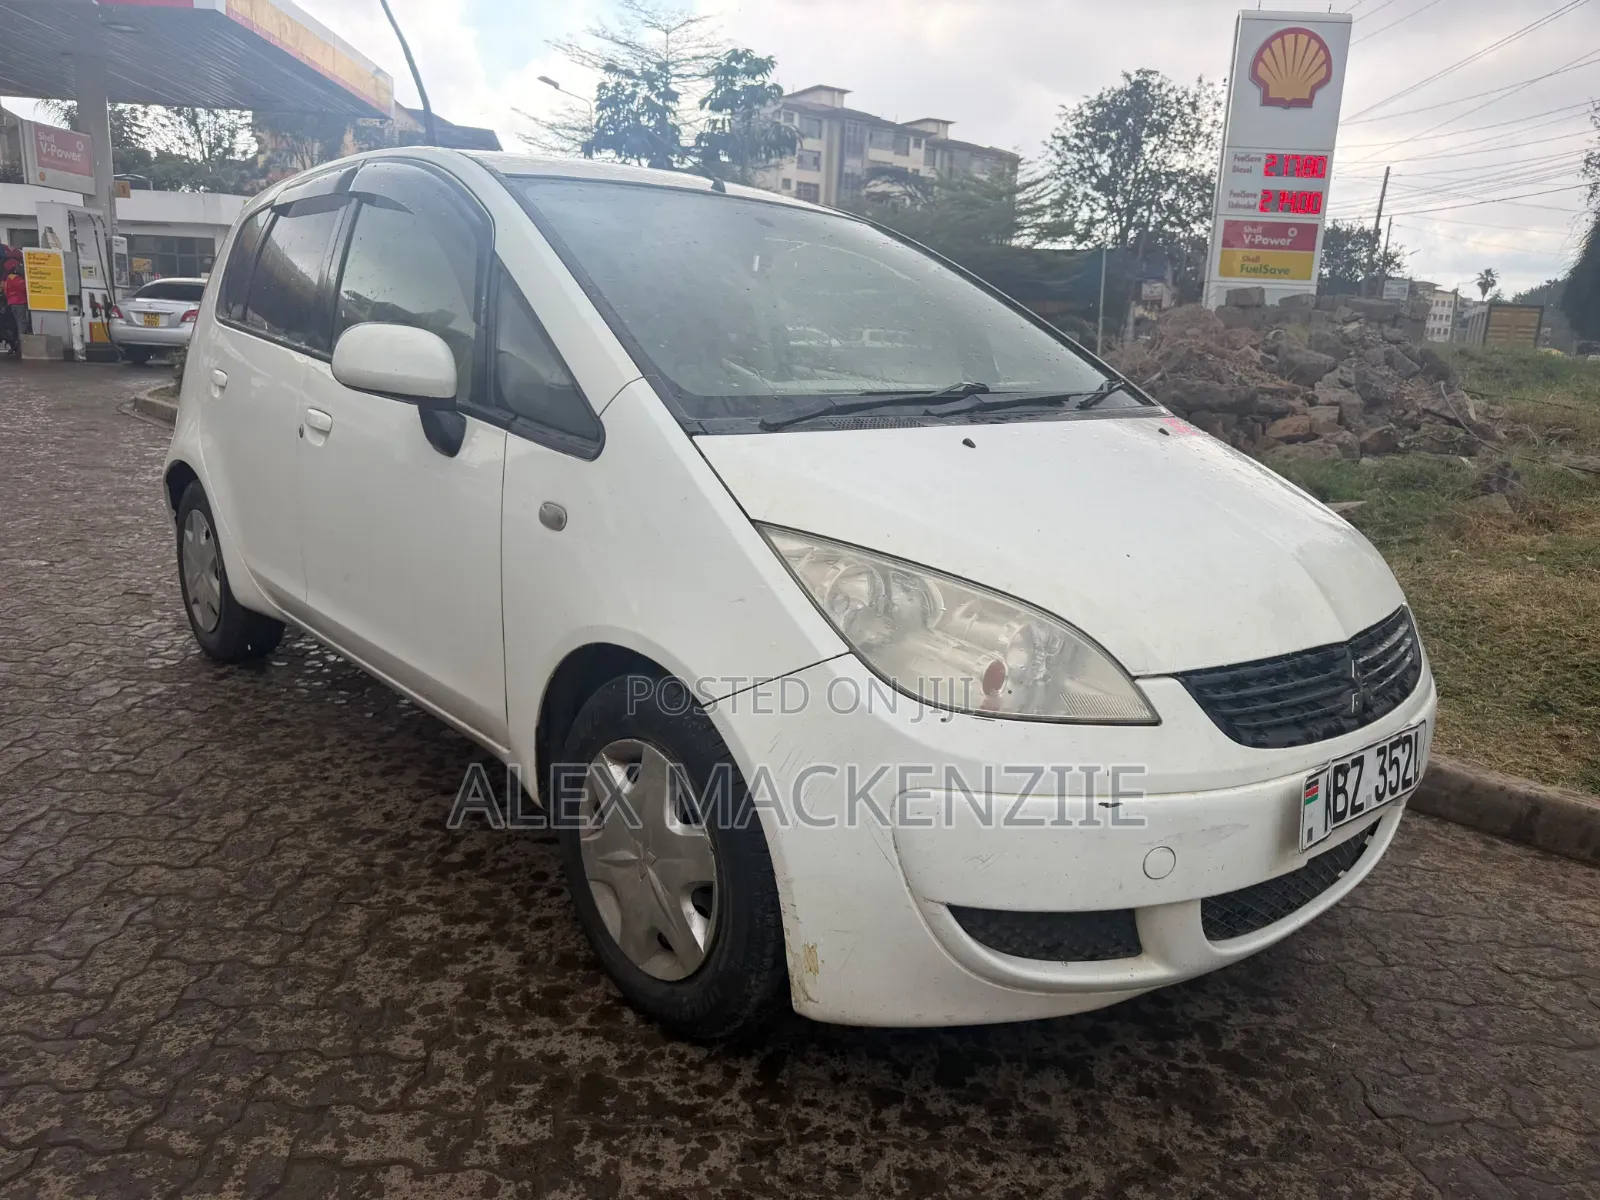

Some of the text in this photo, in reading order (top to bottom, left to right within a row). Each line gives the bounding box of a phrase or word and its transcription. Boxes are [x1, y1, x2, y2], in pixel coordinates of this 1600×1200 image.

[38, 131, 55, 143] Shell
[40, 140, 82, 162] V-Power
[1243, 225, 1262, 234] Shell
[1243, 234, 1292, 246] V-Power
[1242, 255, 1260, 263] Shell
[1240, 264, 1290, 275] FuelSave
[1374, 731, 1421, 802] 352L
